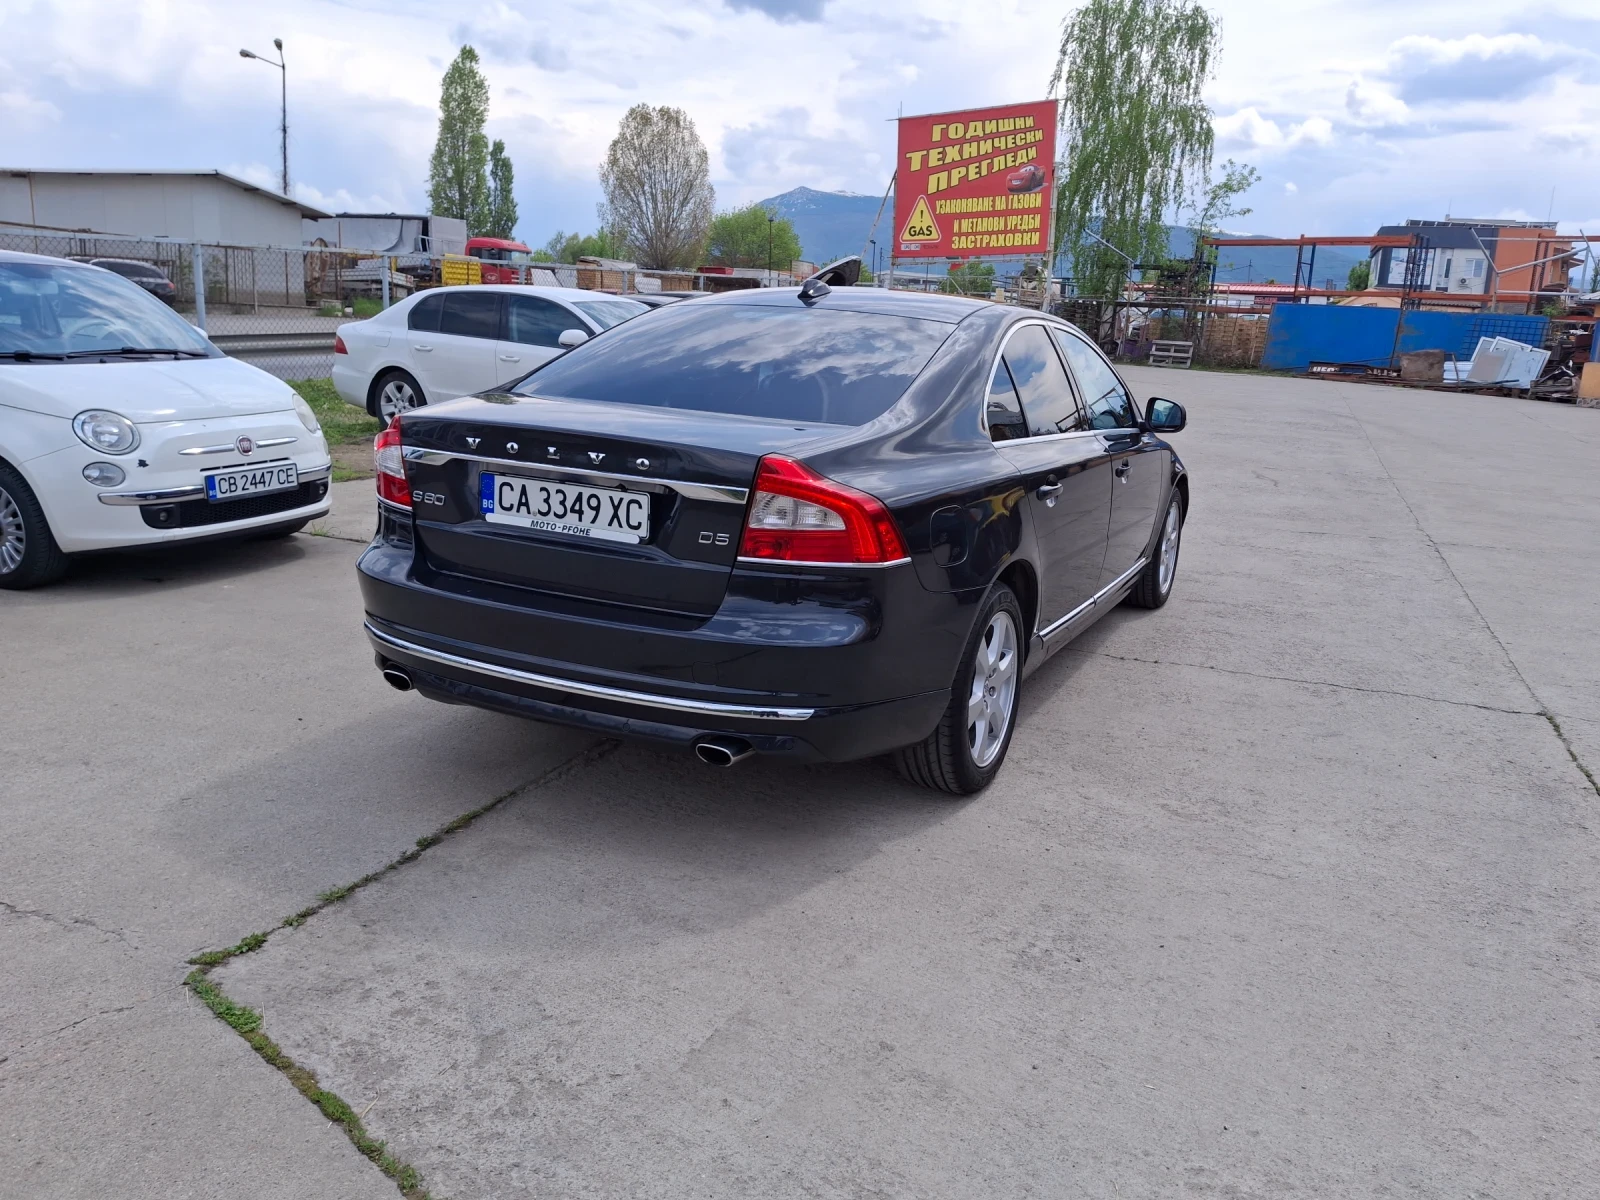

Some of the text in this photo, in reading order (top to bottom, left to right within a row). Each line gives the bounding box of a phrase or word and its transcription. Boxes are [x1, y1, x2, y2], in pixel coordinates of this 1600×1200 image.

[931, 115, 1034, 142] ГОДИШНИ
[906, 129, 1043, 172] ТЕХНИЧЕСКИ
[927, 146, 1037, 195] ПРЕГЛЕДИ
[935, 193, 1042, 215] УЗАКОНЯВАНЕ НА ГАЗОВИ
[908, 225, 933, 237] GAS
[953, 214, 1041, 234] И МЕТАНОВИ УРЕДБИ
[951, 231, 1040, 249] ЗАСТРАХОВКИ
[465, 436, 651, 471] VOLVO
[412, 490, 446, 506] S80
[482, 498, 494, 509] BG
[530, 520, 592, 537] MOTO-PFOHE
[698, 531, 730, 546] D5
